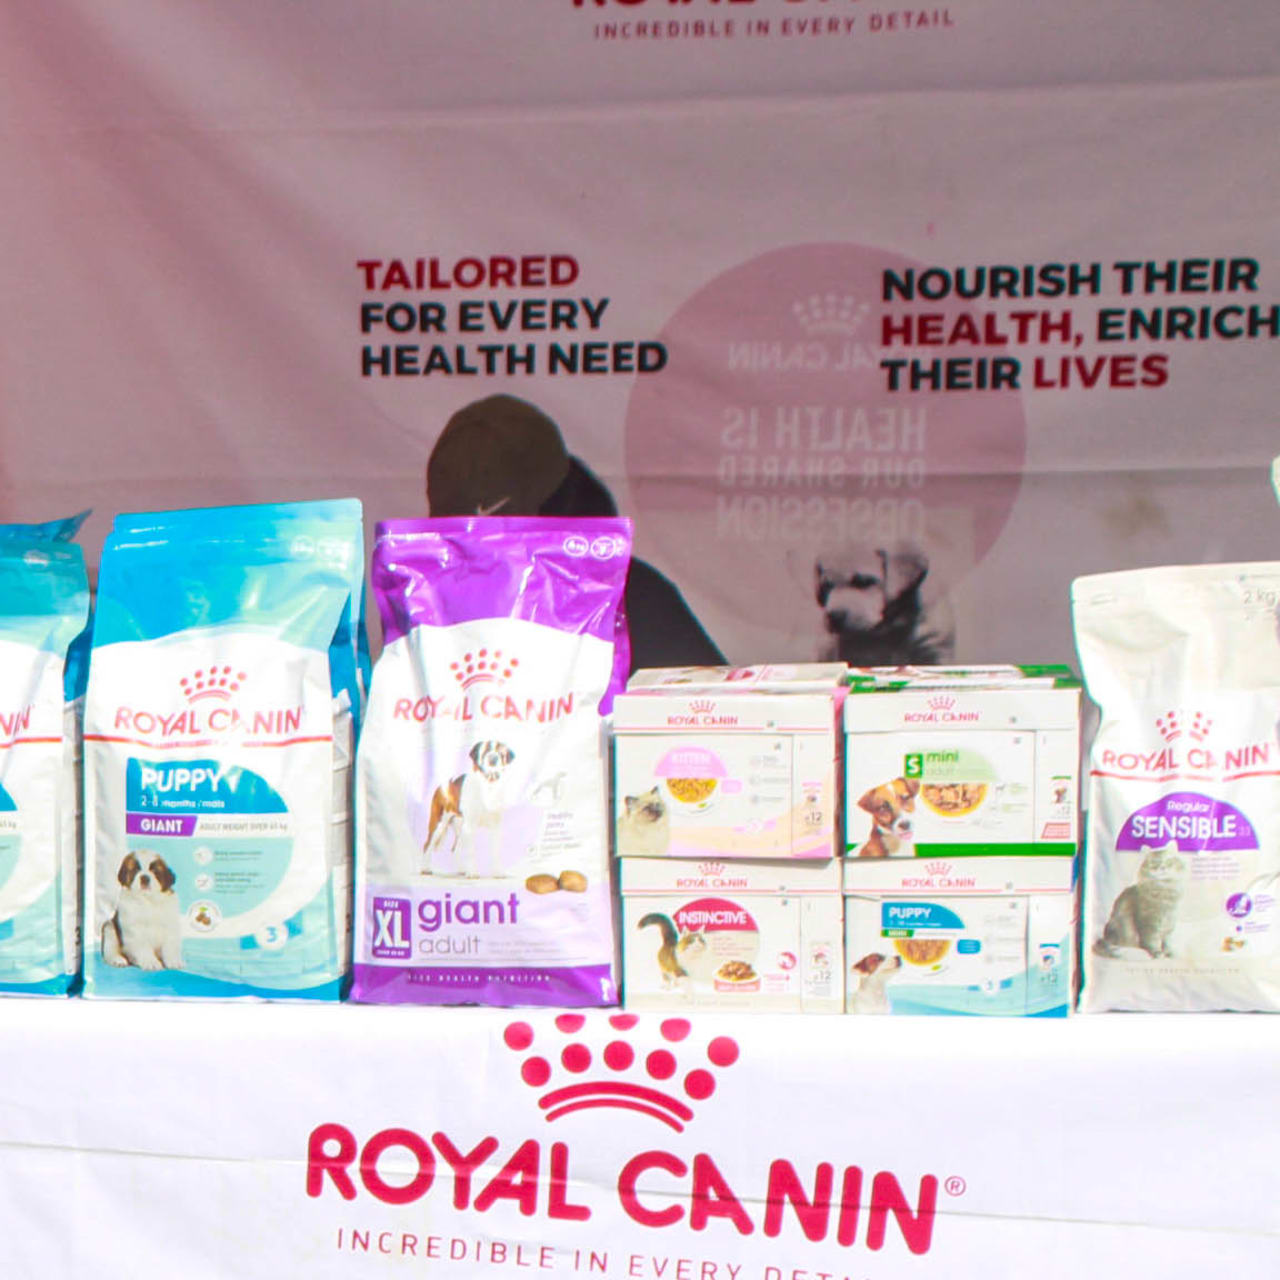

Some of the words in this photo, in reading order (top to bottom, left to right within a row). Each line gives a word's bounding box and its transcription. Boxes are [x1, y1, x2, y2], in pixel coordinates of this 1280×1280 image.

[594, 19, 735, 40] INCREDIBLE
[746, 19, 770, 37] IN
[781, 16, 856, 37] EVERY
[869, 9, 955, 32] DETAIL
[357, 254, 580, 291] TAILORED
[882, 263, 1102, 302] NOURISH
[1113, 257, 1260, 296] THEIR
[360, 301, 447, 333] FOR
[458, 297, 610, 332] EVERY
[881, 309, 1084, 349] HEALTH,
[1097, 304, 1280, 343] ENRICH
[361, 343, 536, 377] HEALTH
[548, 340, 669, 375] NEED
[880, 356, 1022, 393] THEIR
[1033, 353, 1170, 390] LIVES
[480, 692, 574, 723] CANIN
[667, 715, 700, 726] ROYAL
[703, 715, 739, 726] CANIN
[904, 712, 939, 722] ROYAL
[942, 711, 979, 722] CANIN
[115, 706, 201, 737] ROYAL
[906, 757, 920, 774] S
[926, 750, 960, 763] mini
[1102, 748, 1180, 771] ROYAL
[140, 767, 224, 793] PUPPY
[1167, 800, 1210, 814] Regular
[140, 818, 183, 833] GIANT
[1131, 814, 1238, 841] SENSIBLE
[676, 878, 709, 889] ROYAL
[901, 878, 935, 888] ROYAL
[417, 892, 520, 932] giant
[678, 911, 748, 925] INSTINCTIVE
[889, 907, 932, 919] PUPPY
[265, 926, 278, 943] 3
[374, 909, 410, 948] XL
[418, 936, 481, 954] adult
[305, 1122, 592, 1223] ROYAL
[337, 1226, 555, 1269] INCREDIBLE
[575, 1250, 608, 1272] IN
